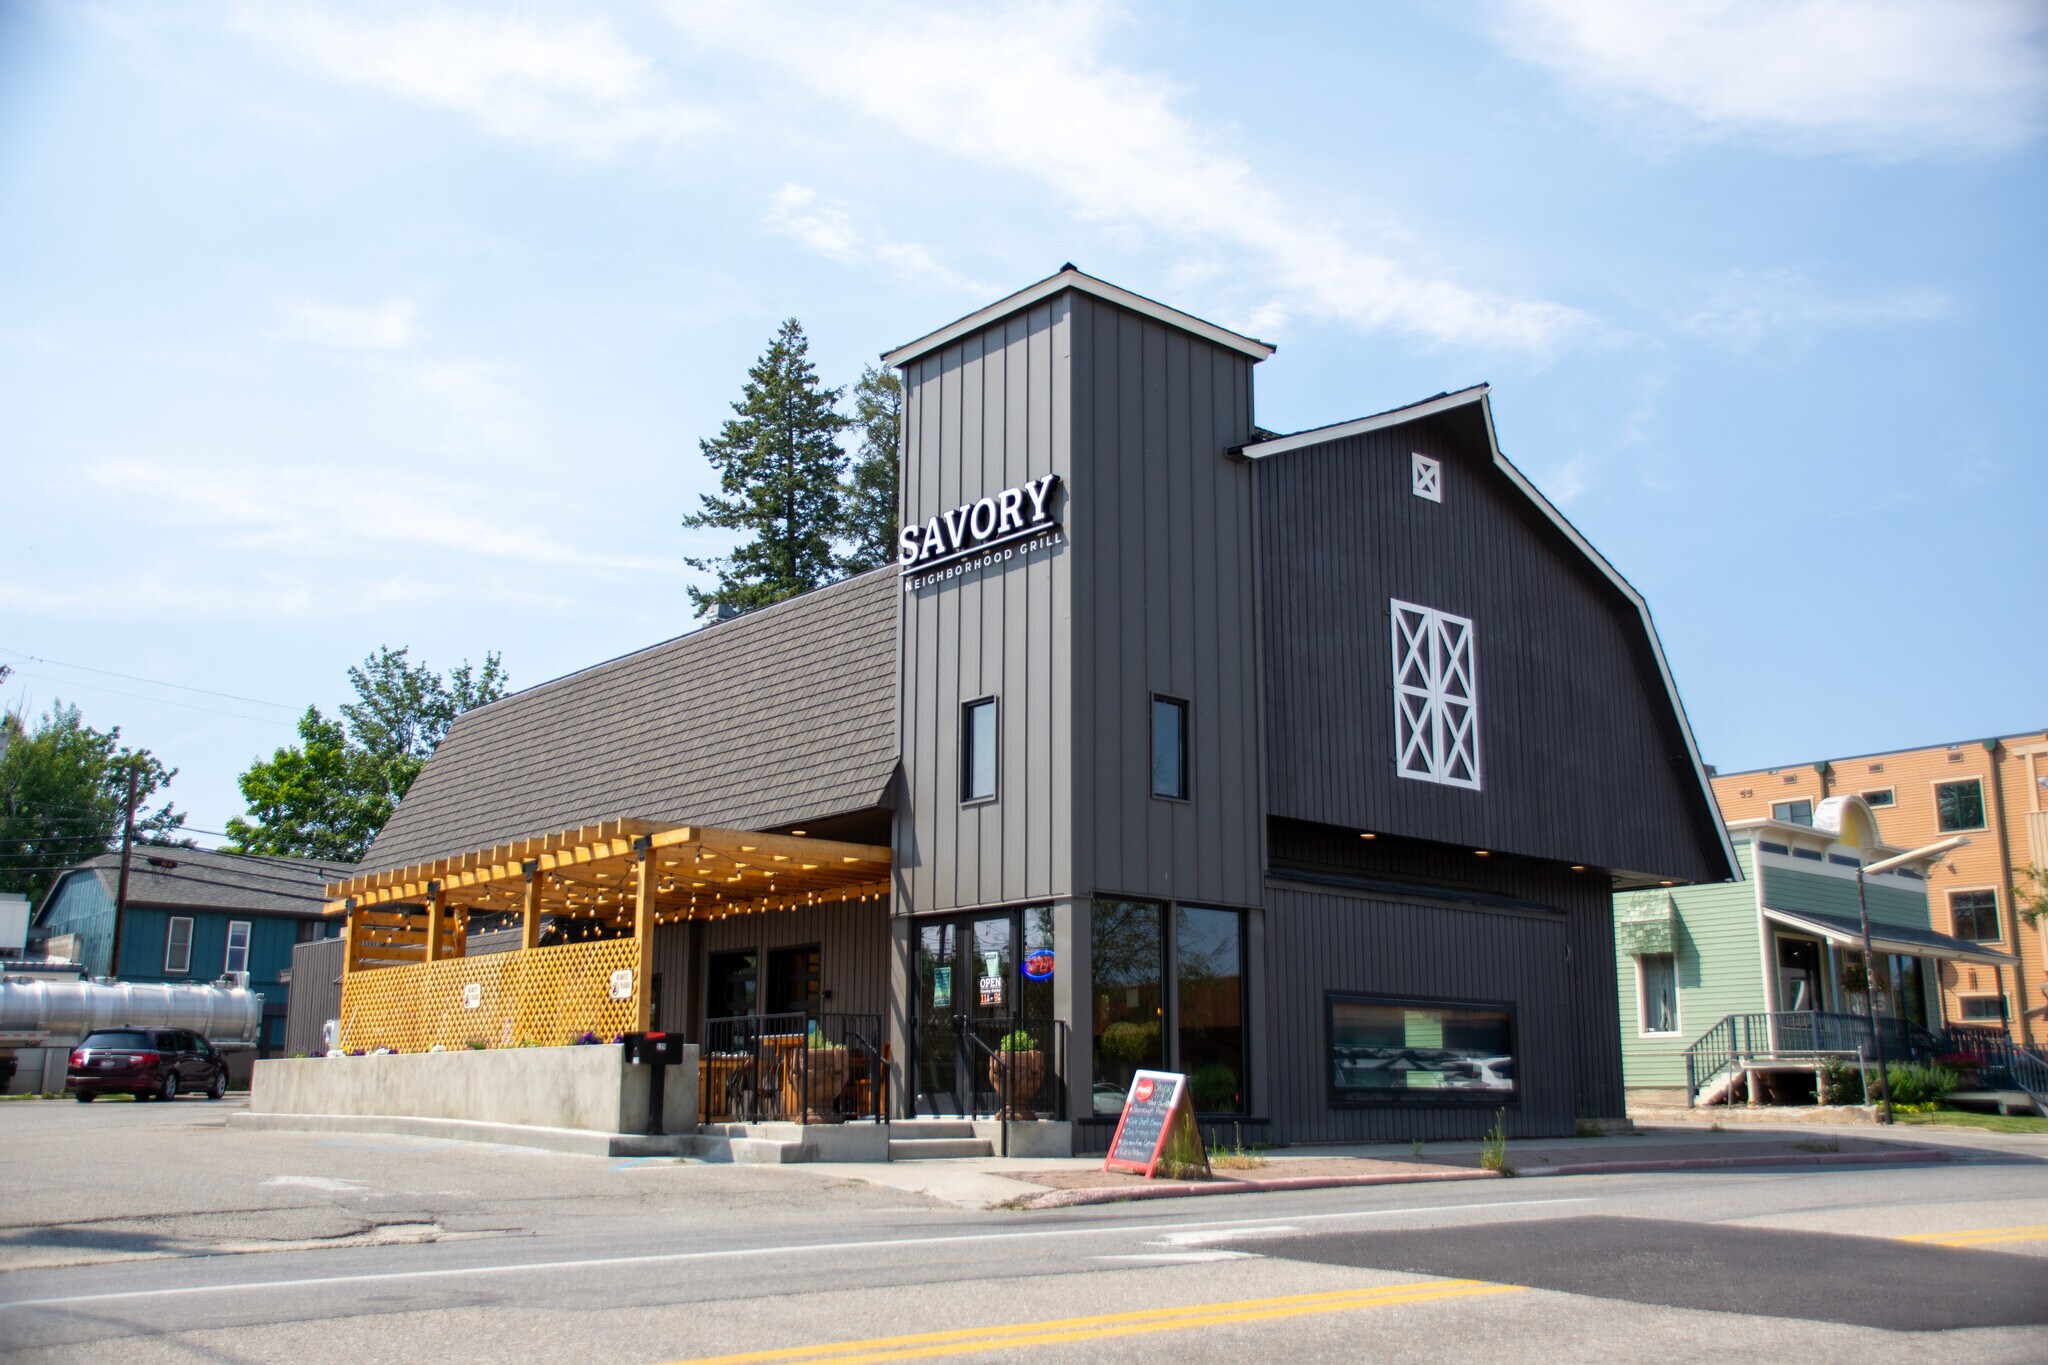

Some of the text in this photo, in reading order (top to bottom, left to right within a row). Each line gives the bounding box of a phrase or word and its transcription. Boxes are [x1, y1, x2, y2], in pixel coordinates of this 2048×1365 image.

[899, 474, 1057, 566] SAVORY
[905, 533, 1062, 592] NEIGHBORHOOD GRILL
[980, 977, 1001, 988] OPEN
